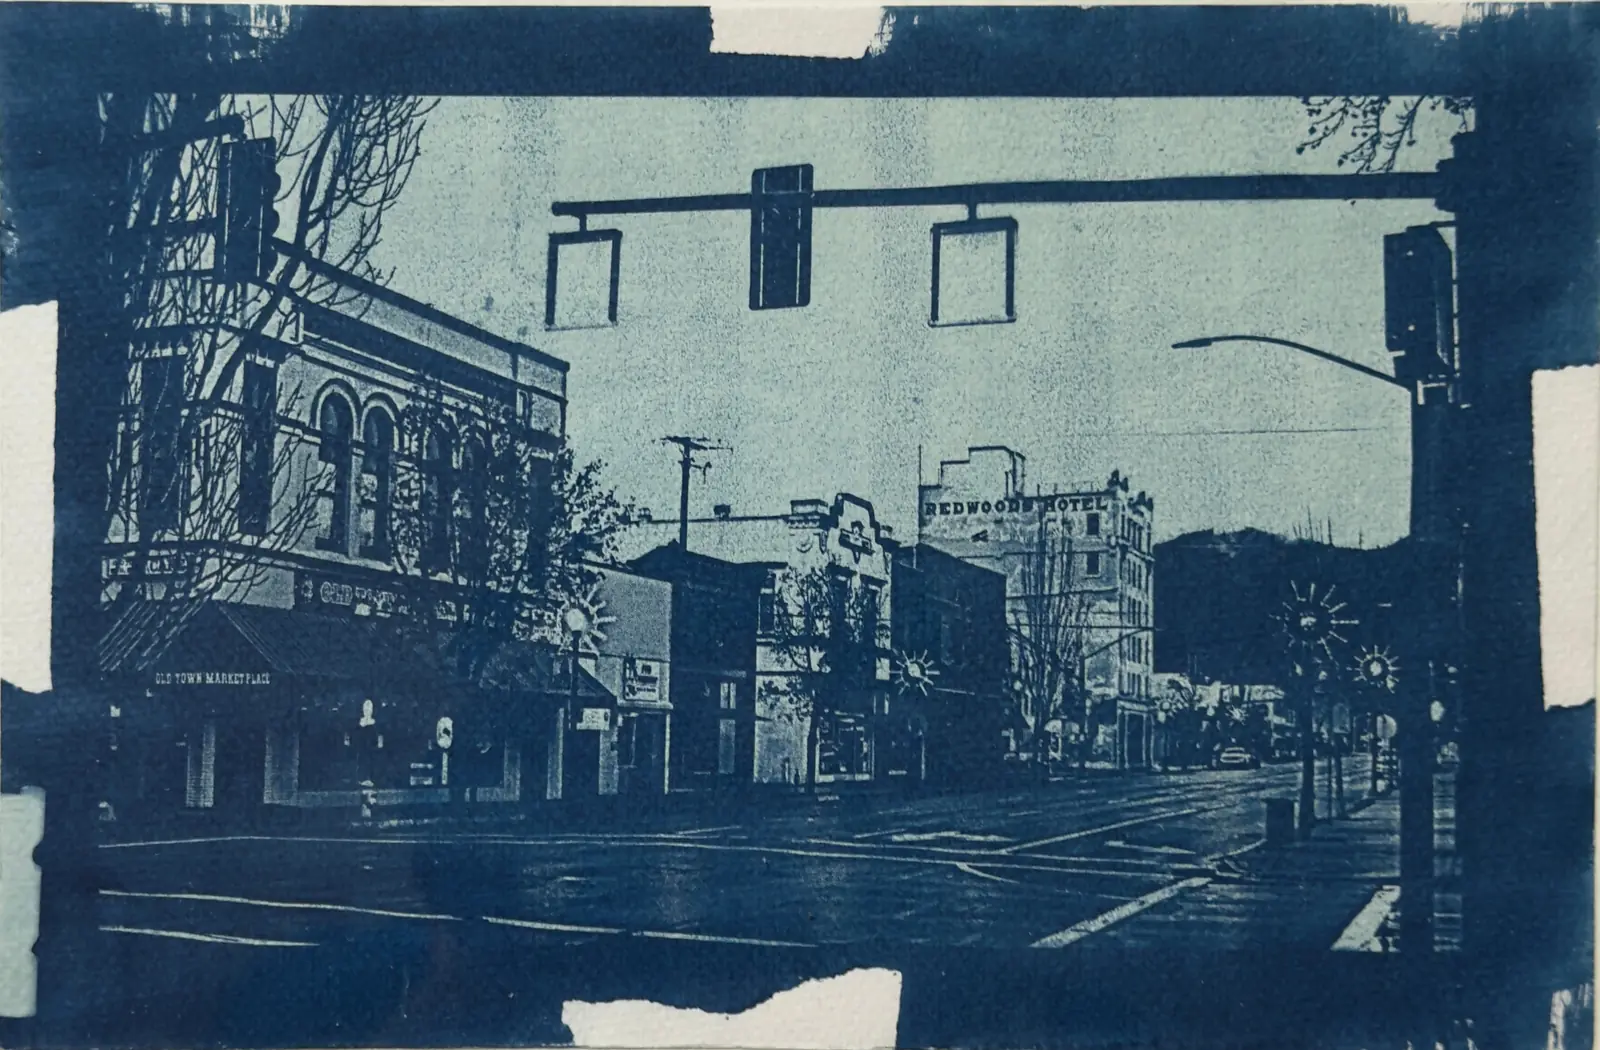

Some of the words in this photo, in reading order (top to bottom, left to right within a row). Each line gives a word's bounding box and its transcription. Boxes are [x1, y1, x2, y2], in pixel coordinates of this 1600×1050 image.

[924, 500, 1034, 517] REDWOOD
[1046, 496, 1108, 512] HOTEL
[155, 672, 172, 685] OLD
[175, 672, 202, 685] TOWN
